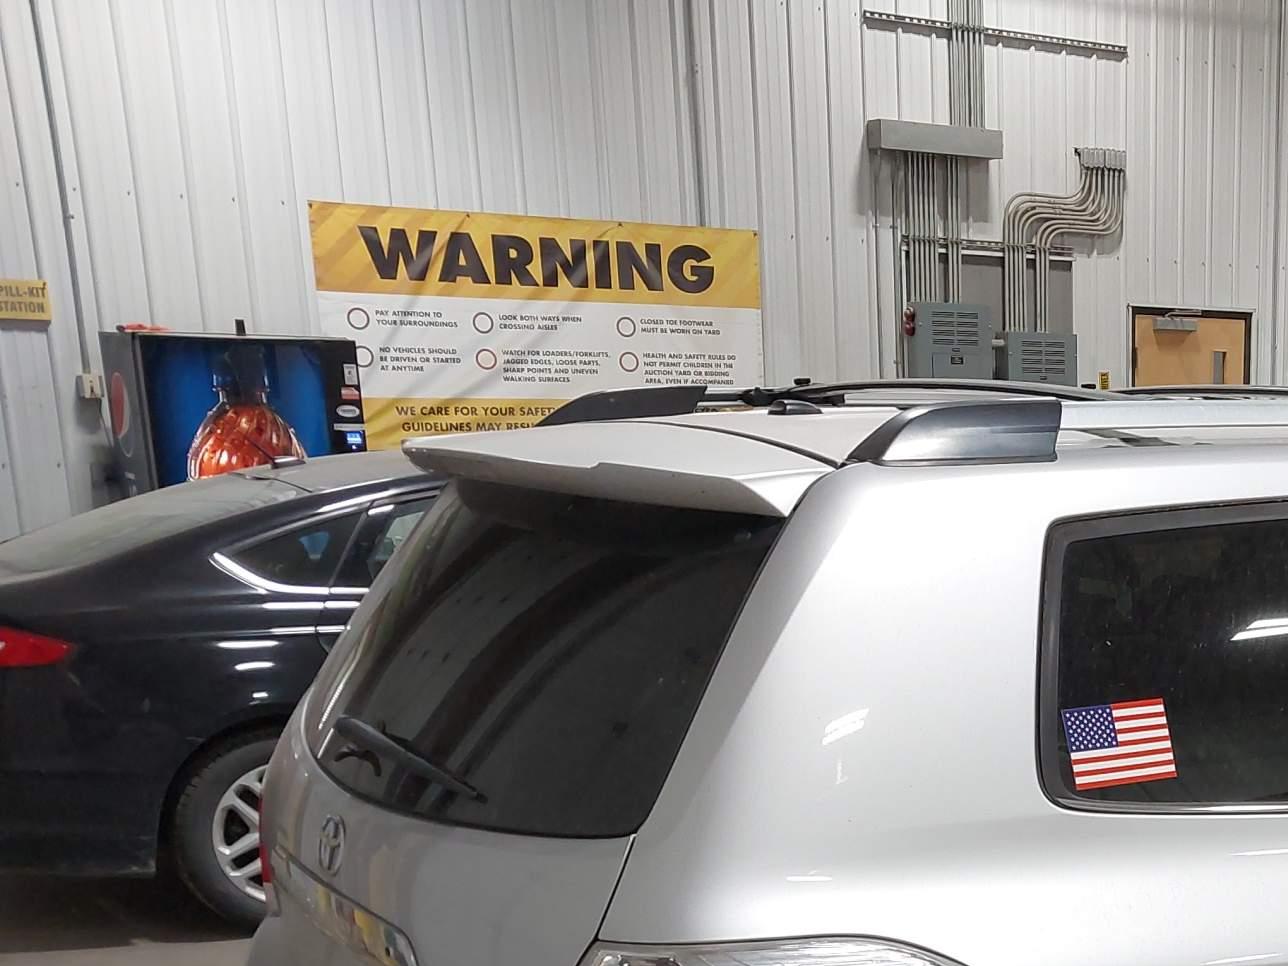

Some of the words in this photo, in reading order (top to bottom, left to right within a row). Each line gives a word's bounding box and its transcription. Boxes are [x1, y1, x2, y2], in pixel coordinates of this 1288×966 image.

[358, 226, 715, 294] WARNING
[399, 320, 458, 328] SURROUNDINGS
[395, 405, 416, 416] WE
[420, 406, 451, 416] CARE
[453, 406, 478, 416] FOR
[481, 406, 516, 417] YOUR
[519, 407, 555, 417] SAFET
[402, 421, 472, 432] GUIDELINES
[475, 422, 501, 431] MAY
